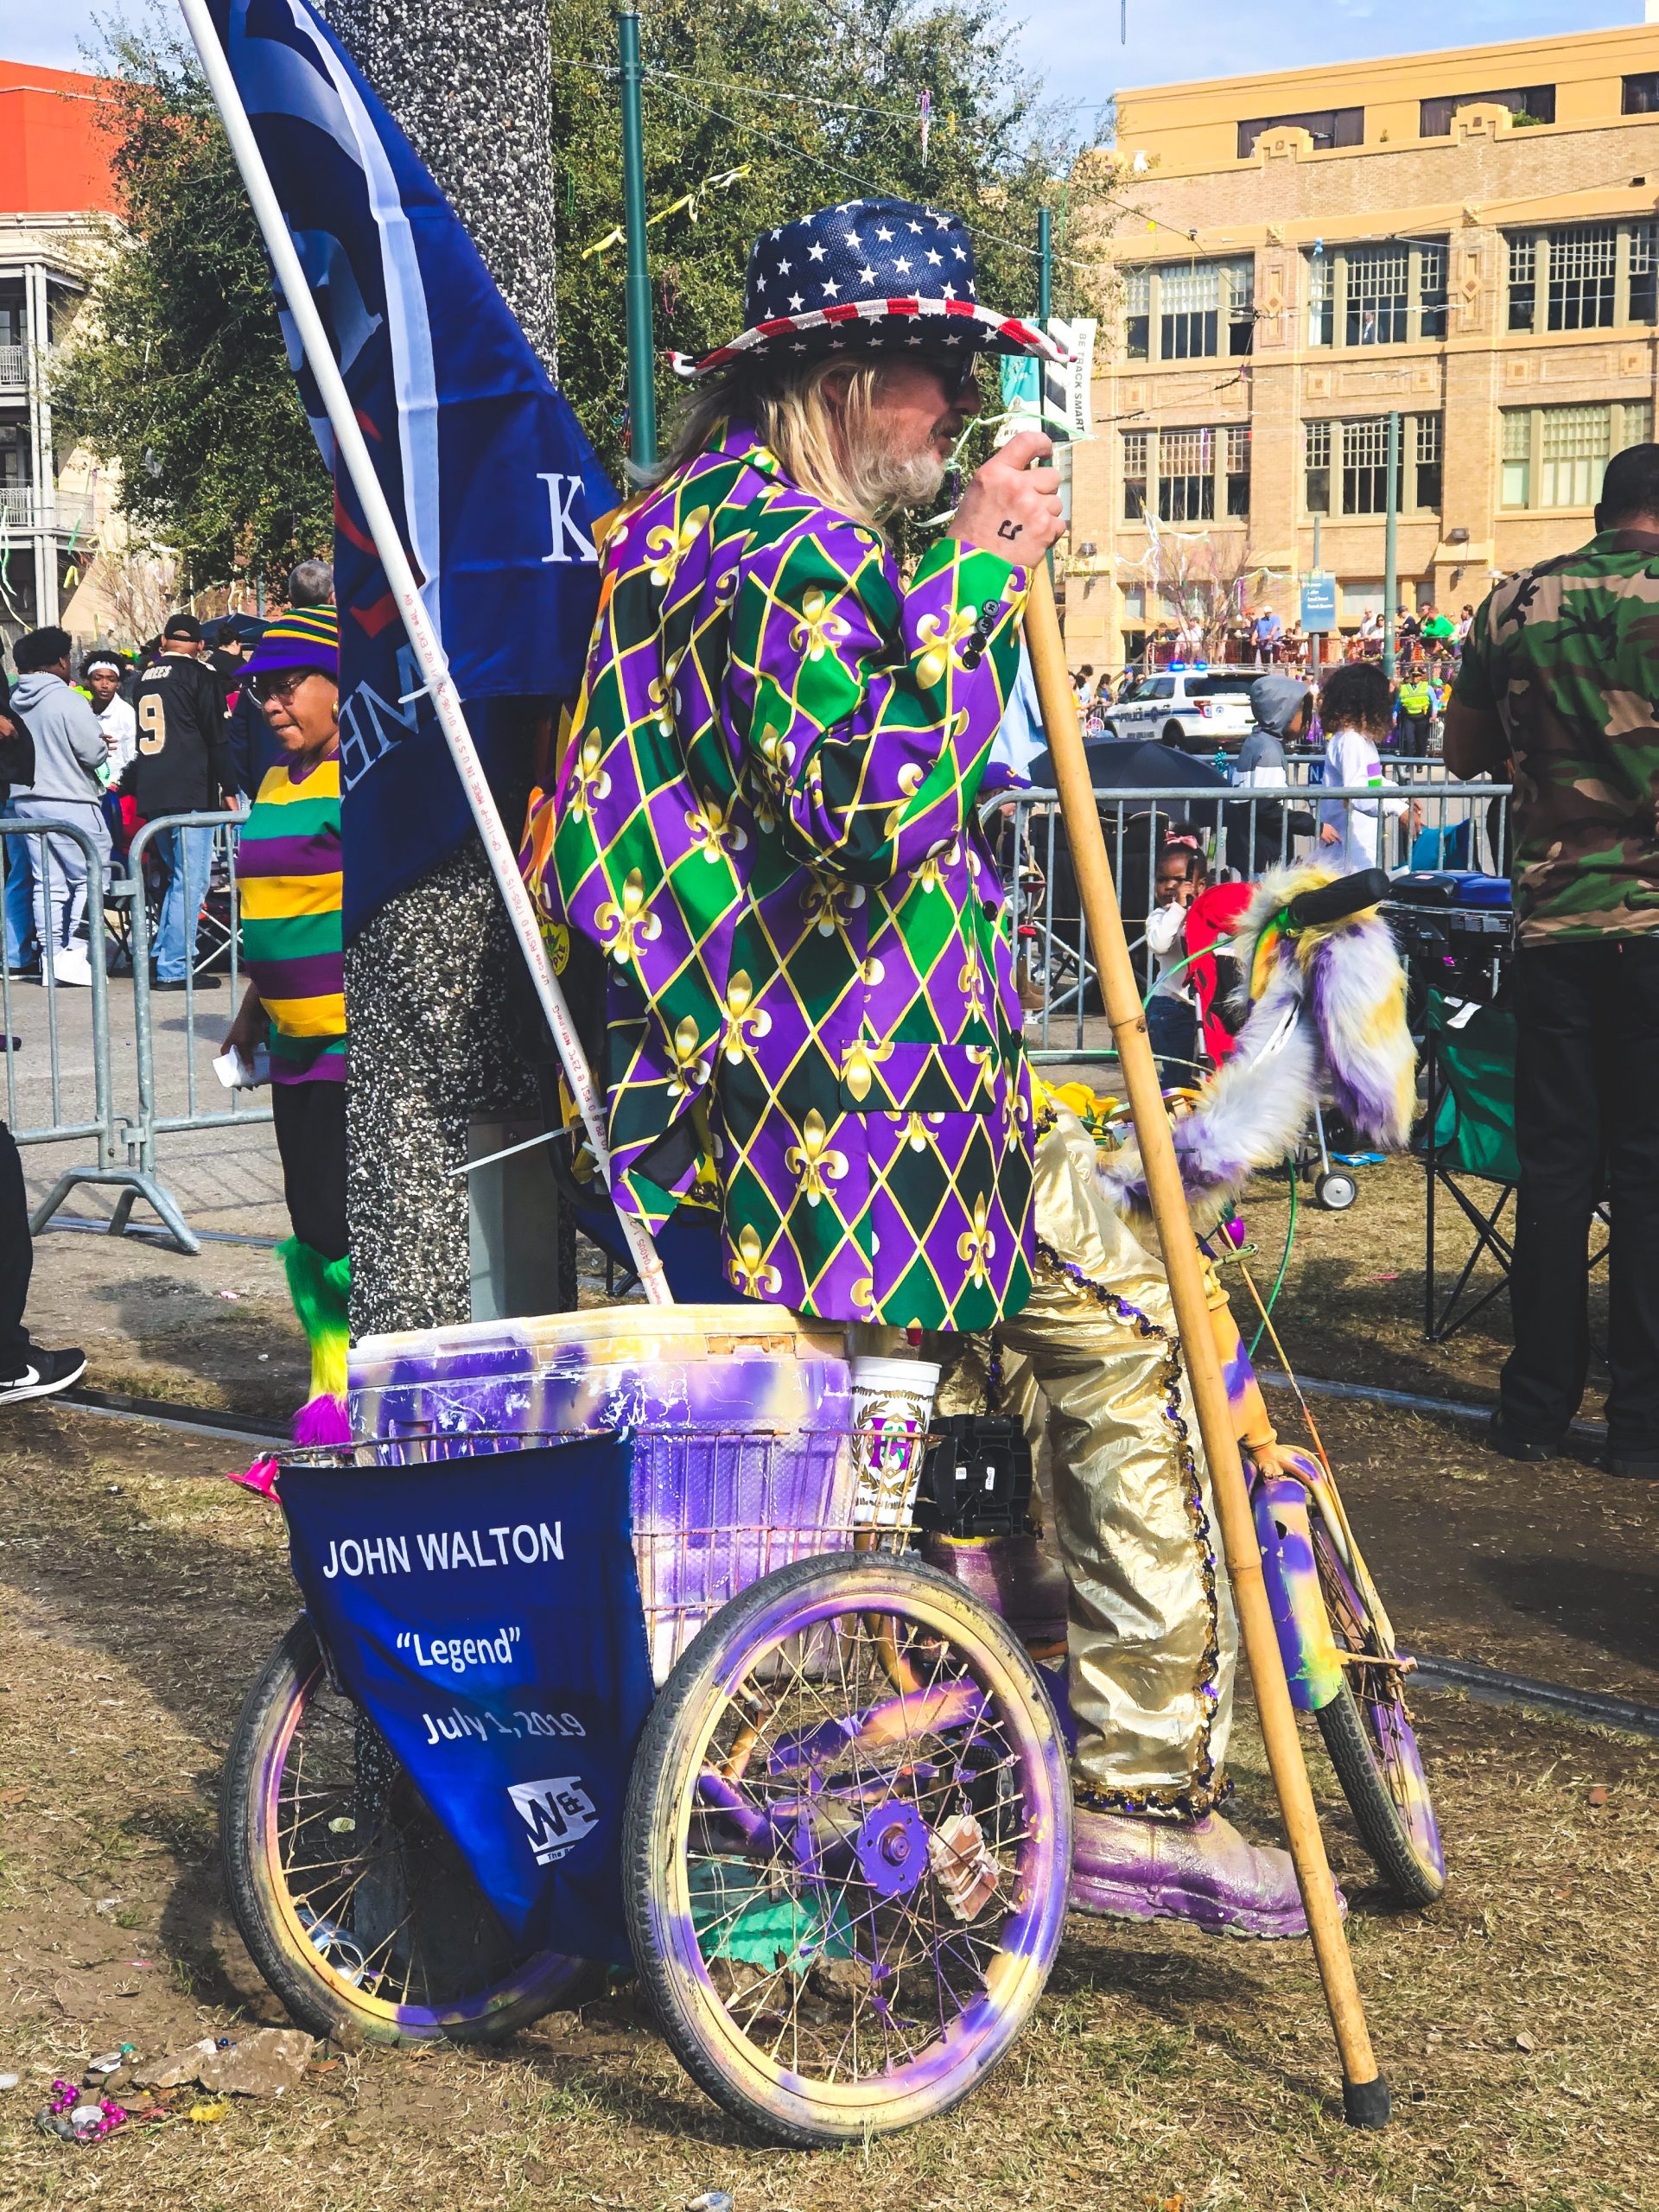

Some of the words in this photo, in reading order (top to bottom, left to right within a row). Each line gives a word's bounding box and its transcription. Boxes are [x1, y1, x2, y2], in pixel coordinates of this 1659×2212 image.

[1078, 334, 1087, 347] BE
[1074, 353, 1085, 389] TRACK
[1074, 392, 1085, 432] SMART
[138, 693, 166, 755] 9
[451, 729, 470, 763] U.S.A.
[464, 765, 475, 778] IN
[470, 780, 486, 804] MADE
[480, 807, 502, 851] CP-110-P
[524, 929, 538, 952] ASTM
[580, 1084, 593, 1102] PSI
[587, 1104, 599, 1122] 60
[594, 1124, 605, 1136] PR
[635, 1237, 652, 1266] 04005
[322, 1535, 411, 1579] JOHN
[416, 1521, 564, 1571] WALTON
[422, 1707, 488, 1745] July
[513, 1711, 587, 1737] 2019
